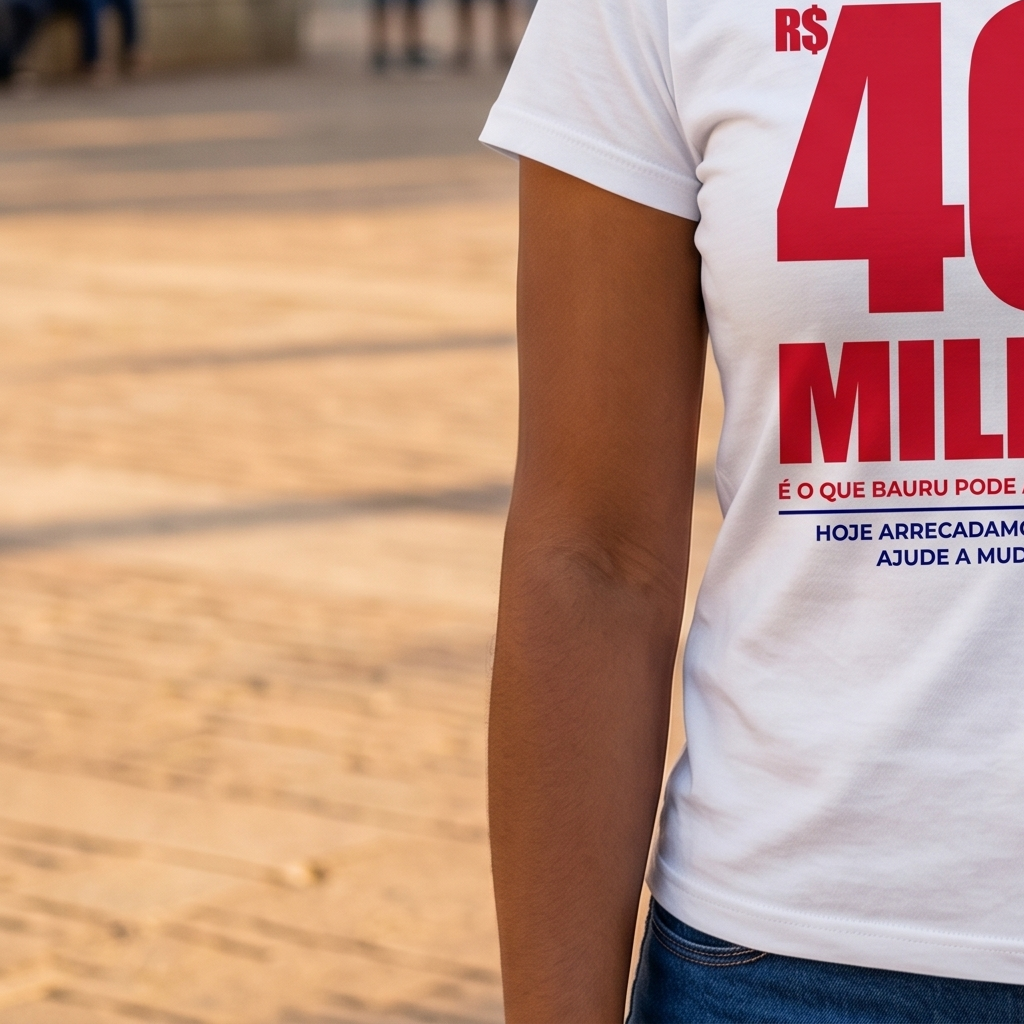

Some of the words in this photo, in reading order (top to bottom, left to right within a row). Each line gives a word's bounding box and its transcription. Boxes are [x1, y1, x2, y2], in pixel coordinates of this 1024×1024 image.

[775, 4, 829, 55] R$
[778, 479, 791, 501] É
[797, 482, 815, 500] O
[820, 481, 865, 503] QUE
[871, 479, 949, 498] BAURU
[955, 477, 1016, 496] PODE
[816, 524, 873, 542] HOJE
[876, 548, 949, 567] AJUDE
[955, 547, 971, 564] A
